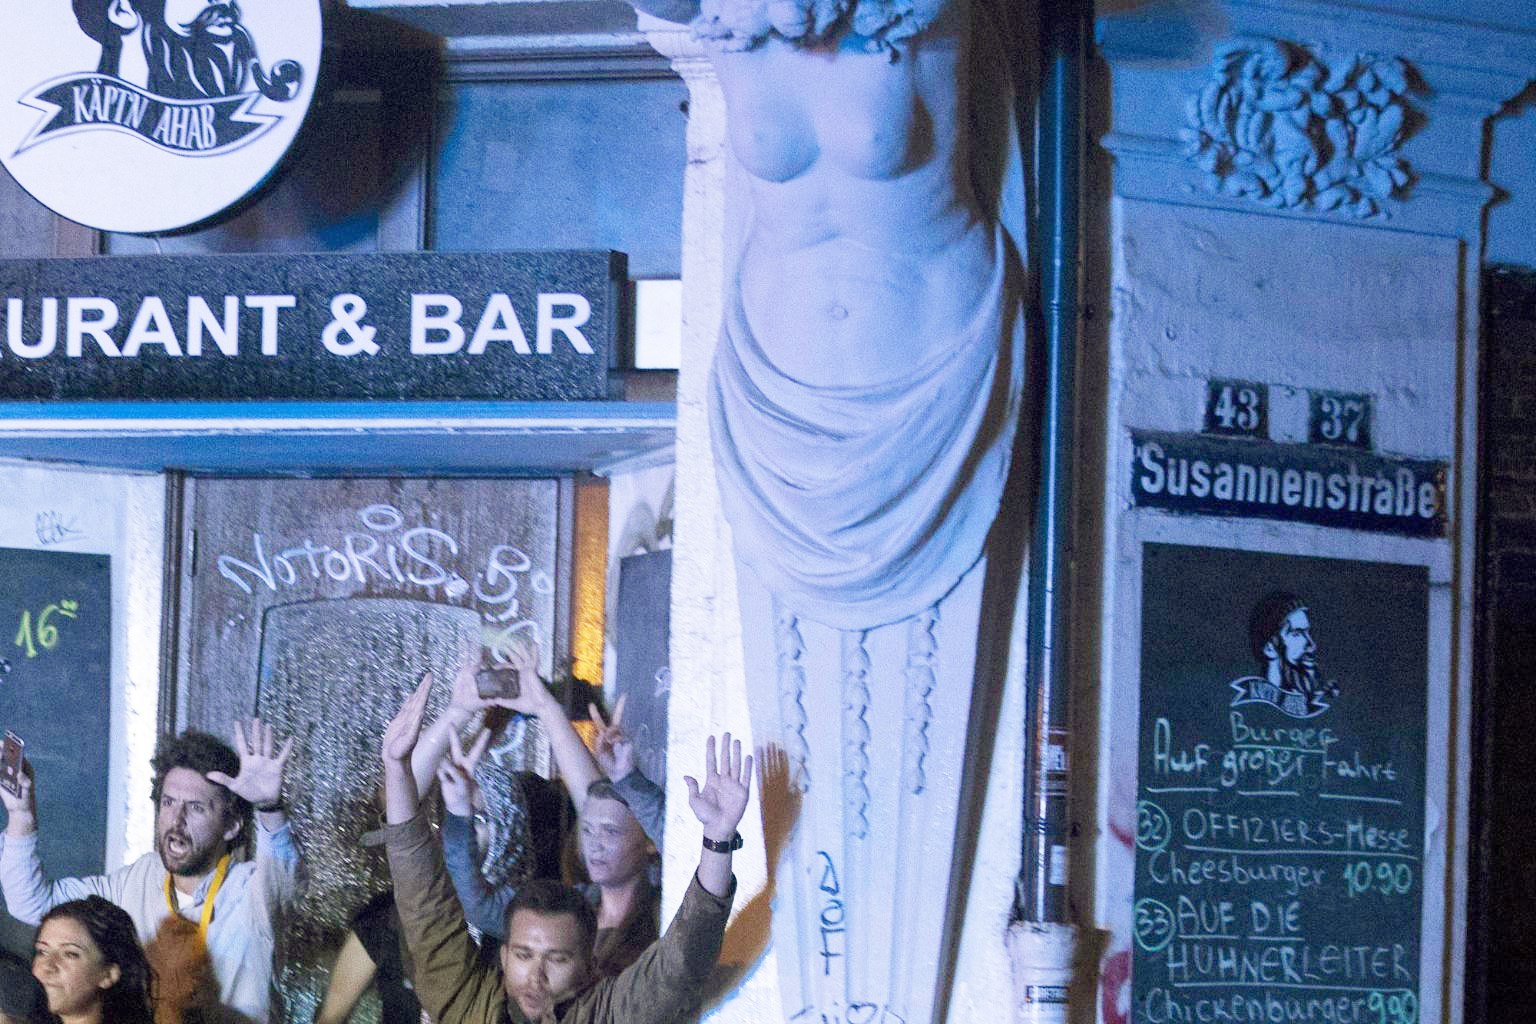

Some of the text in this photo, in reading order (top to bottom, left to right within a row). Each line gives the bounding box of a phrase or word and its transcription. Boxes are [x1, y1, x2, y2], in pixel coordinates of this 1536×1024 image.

[152, 104, 217, 149] AHAB
[321, 291, 379, 356] &
[409, 291, 594, 357] BAR
[1214, 384, 1260, 430] 43
[1320, 397, 1364, 442] 37
[1138, 442, 1439, 519] Susannenstraße
[1153, 717, 1210, 776] Auf
[1177, 896, 1236, 935] AUF
[1250, 901, 1301, 935] DIE
